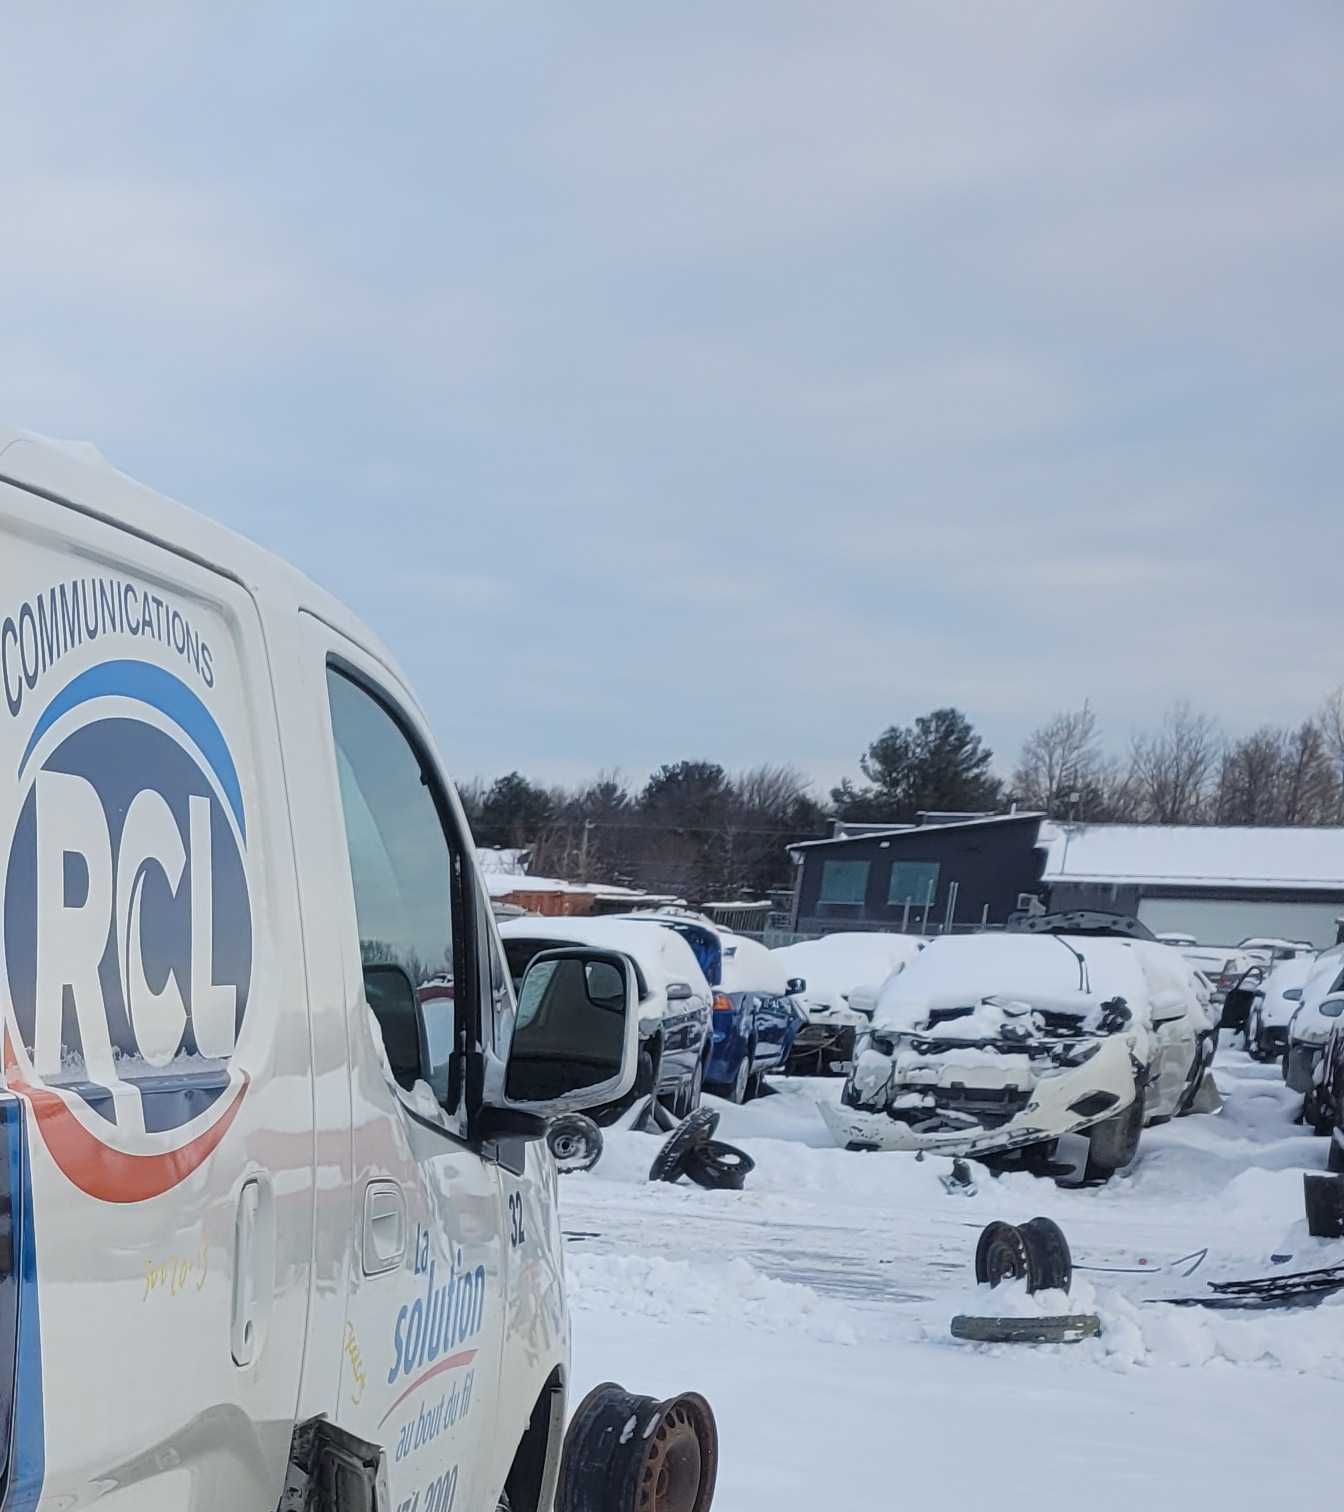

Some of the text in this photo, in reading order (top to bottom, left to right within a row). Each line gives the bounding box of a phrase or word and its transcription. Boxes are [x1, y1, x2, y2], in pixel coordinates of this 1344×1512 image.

[1, 577, 214, 717] COMMUNICATIONS
[35, 769, 237, 1128] RCL
[387, 1248, 486, 1385] solution
[414, 1222, 430, 1276] La
[395, 1368, 475, 1463] au bout du fil
